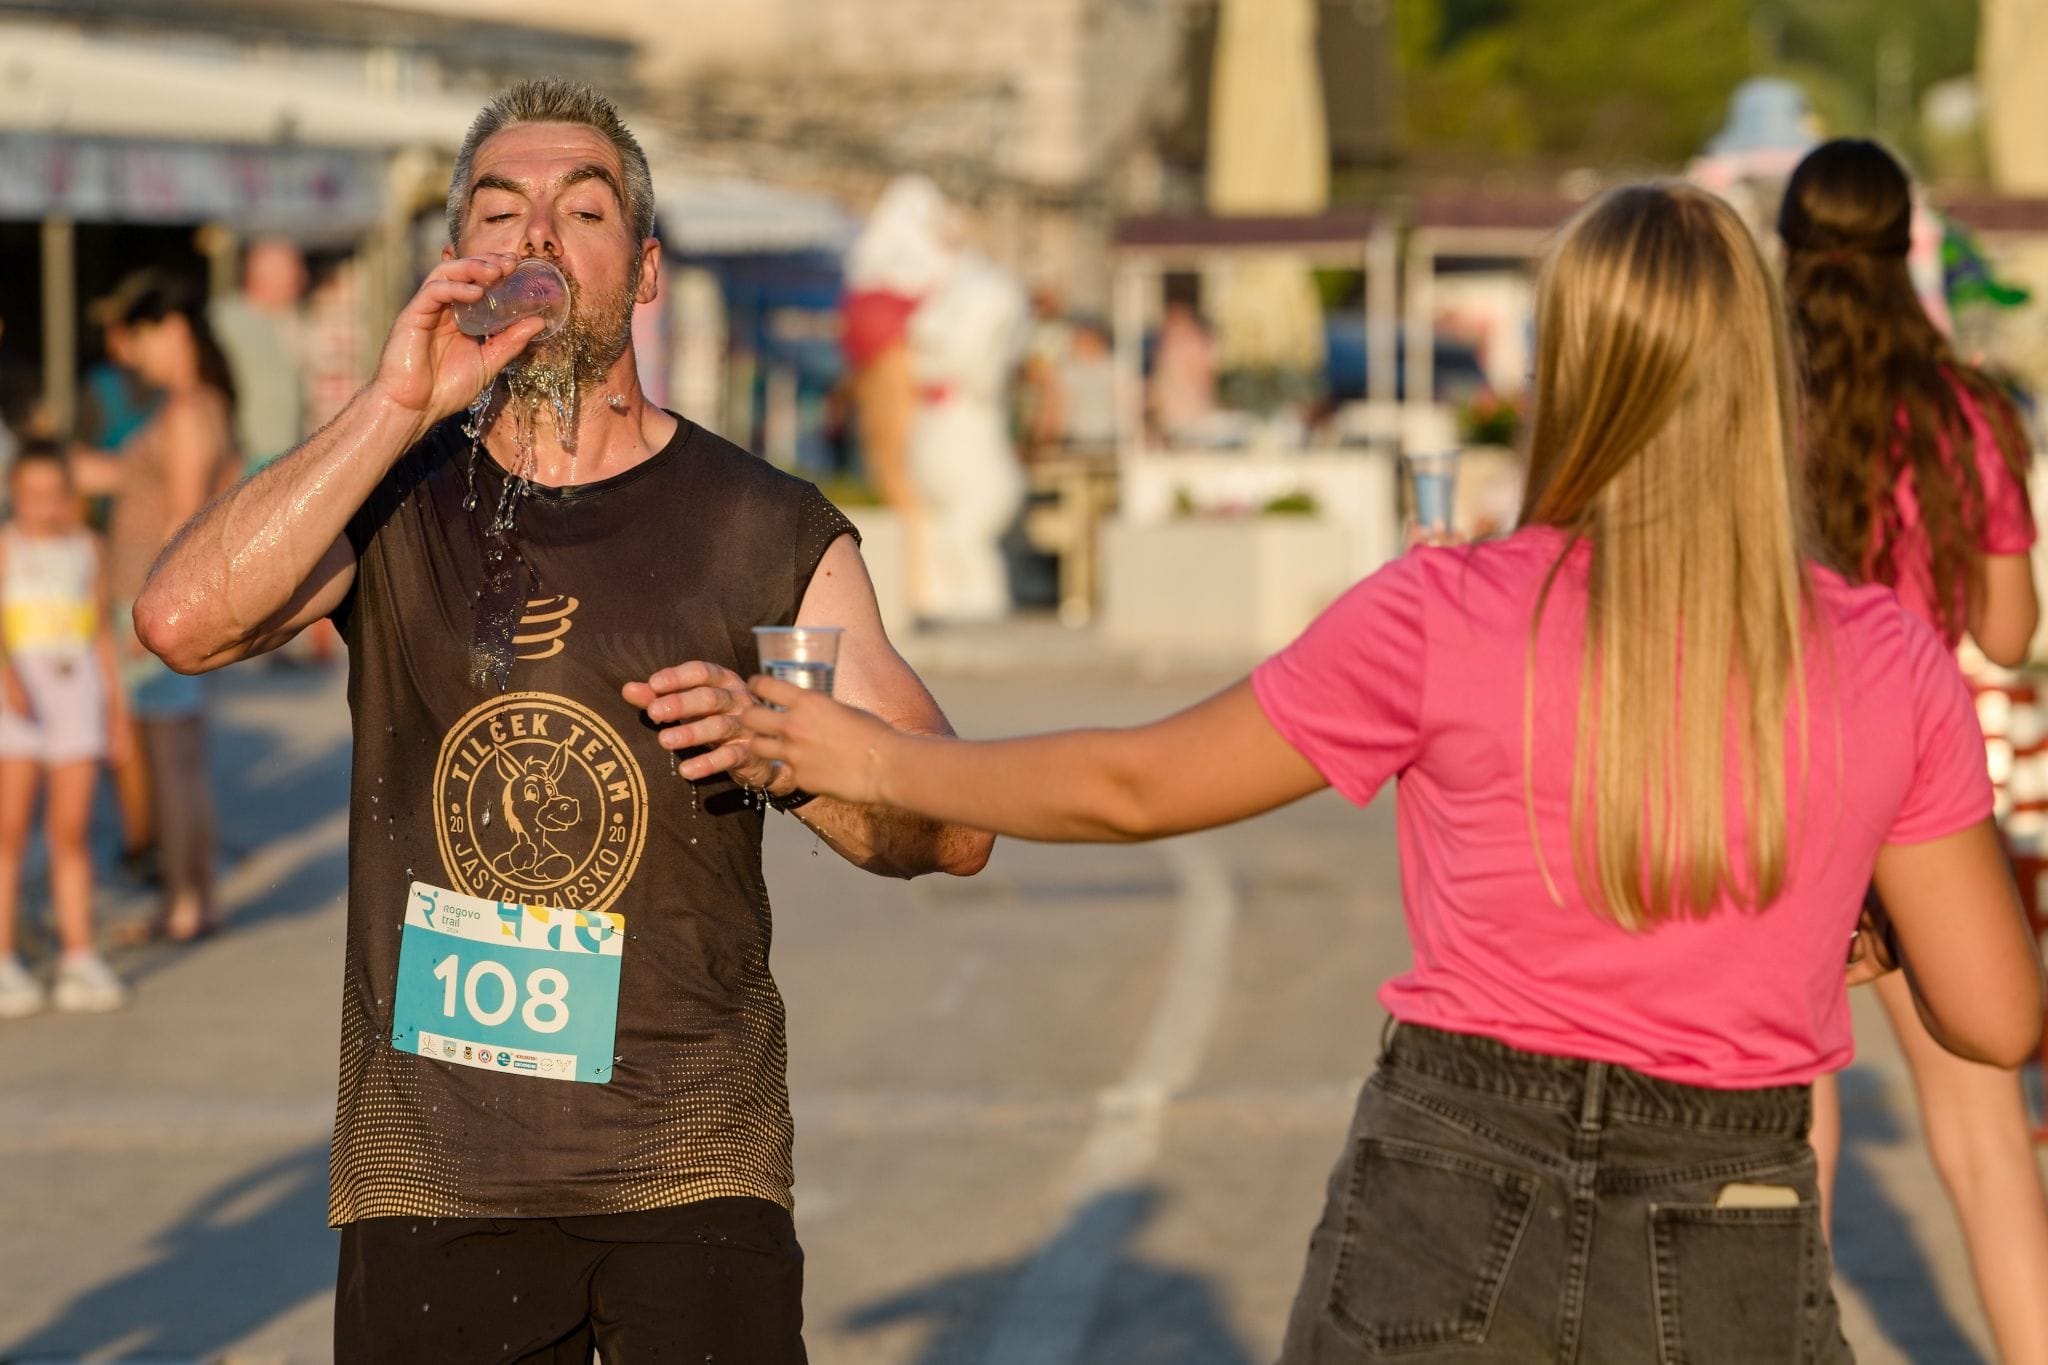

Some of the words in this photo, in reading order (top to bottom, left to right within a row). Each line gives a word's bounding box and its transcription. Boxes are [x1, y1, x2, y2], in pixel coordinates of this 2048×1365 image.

[452, 713, 550, 782] TILČEK
[567, 724, 631, 803] TEAM
[450, 816, 464, 833] 20
[608, 826, 626, 843] 20
[443, 904, 481, 920] Rogovo
[442, 915, 460, 928] trail
[433, 954, 570, 1034] 108
